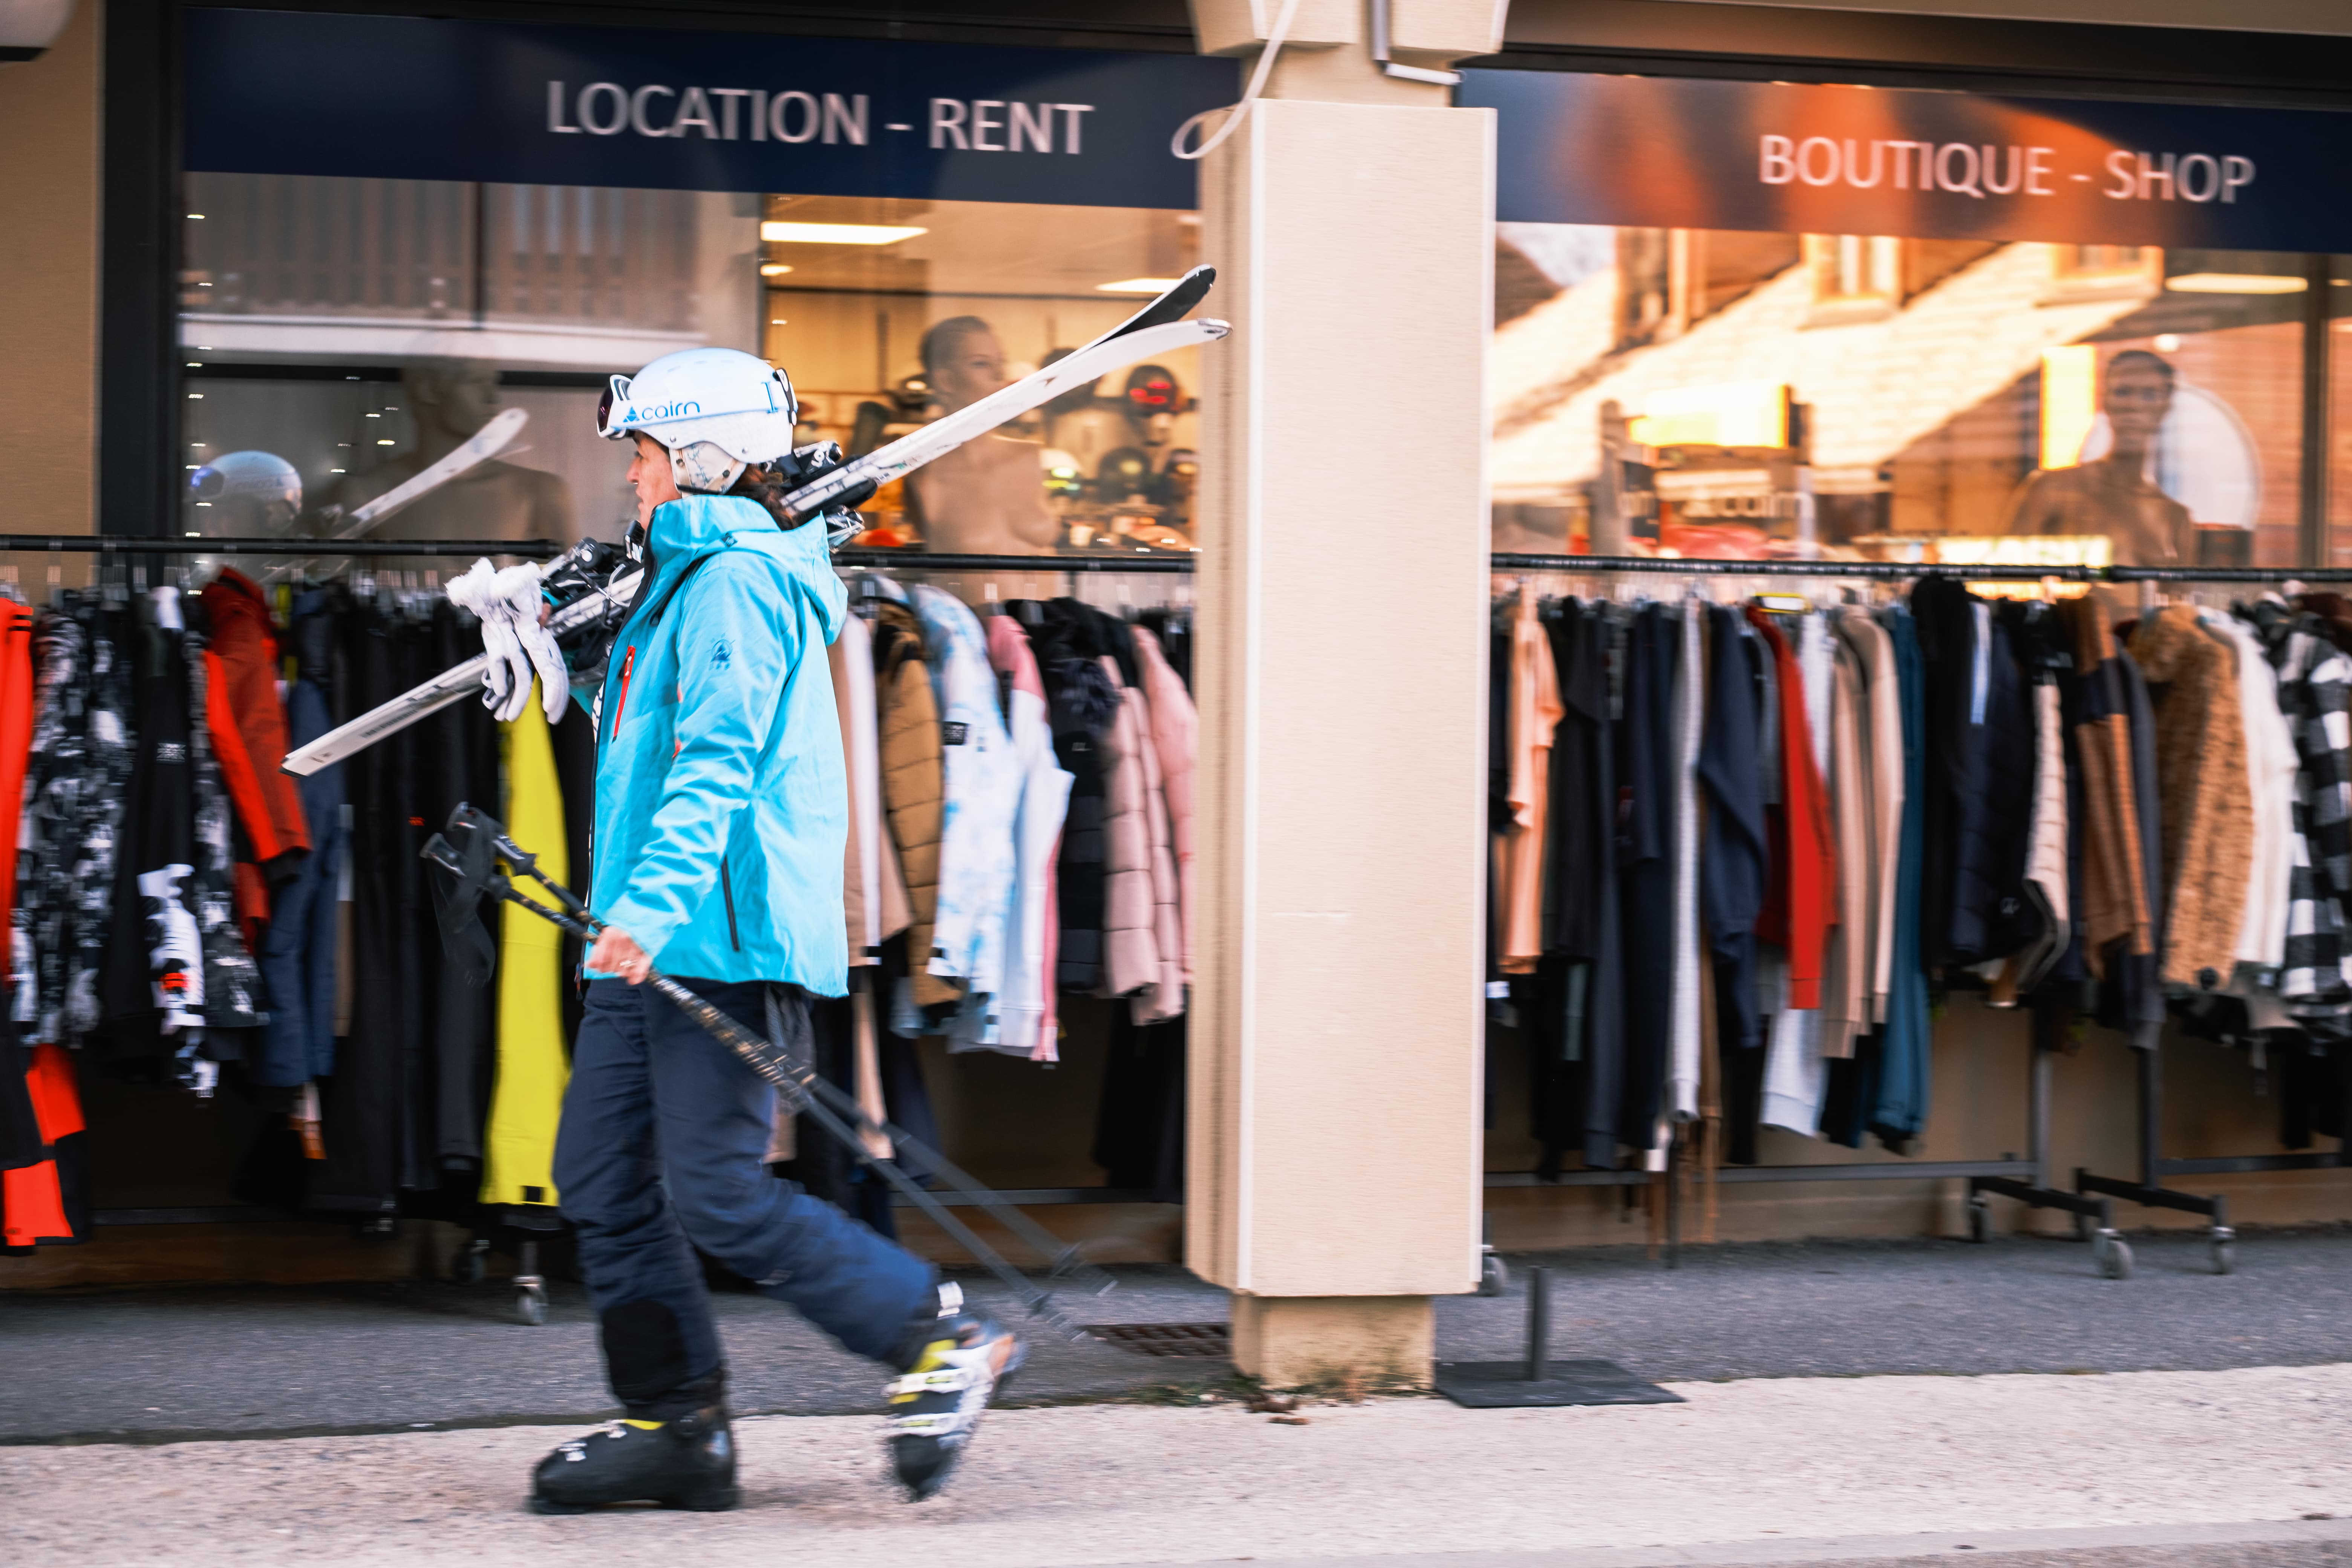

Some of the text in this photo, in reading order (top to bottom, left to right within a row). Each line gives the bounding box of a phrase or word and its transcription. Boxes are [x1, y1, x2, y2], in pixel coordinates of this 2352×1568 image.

[547, 80, 868, 145] LOCATION
[929, 98, 1095, 154] RENT
[1759, 134, 2055, 198] BOUTIQUE
[2104, 149, 2256, 204] SHOP
[642, 400, 700, 420] cairn
